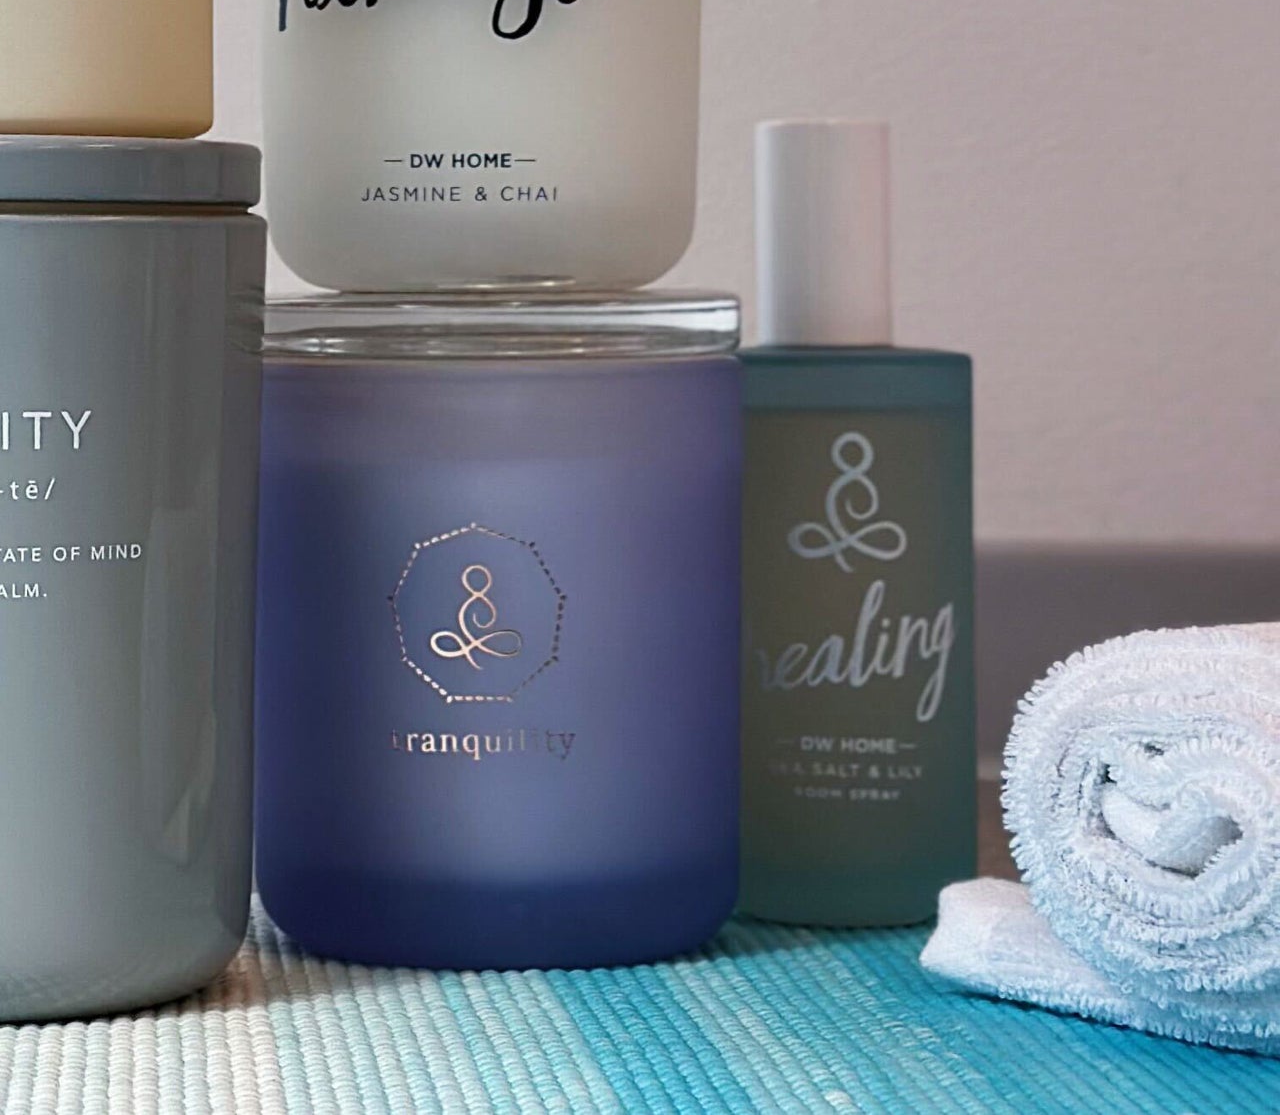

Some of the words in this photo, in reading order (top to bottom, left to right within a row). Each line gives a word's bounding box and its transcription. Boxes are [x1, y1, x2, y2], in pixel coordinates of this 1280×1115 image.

[409, 153, 444, 170] DW
[451, 152, 513, 170] HOME
[360, 186, 463, 204] JASMINE
[474, 186, 489, 203] &
[499, 186, 559, 203] CHAI
[52, 545, 82, 562] OF
[89, 543, 143, 561] MIND
[752, 578, 956, 723] ealing
[390, 729, 577, 761] tranquility
[800, 736, 834, 753] DW
[840, 737, 898, 754] HOME
[811, 762, 860, 779] SALT
